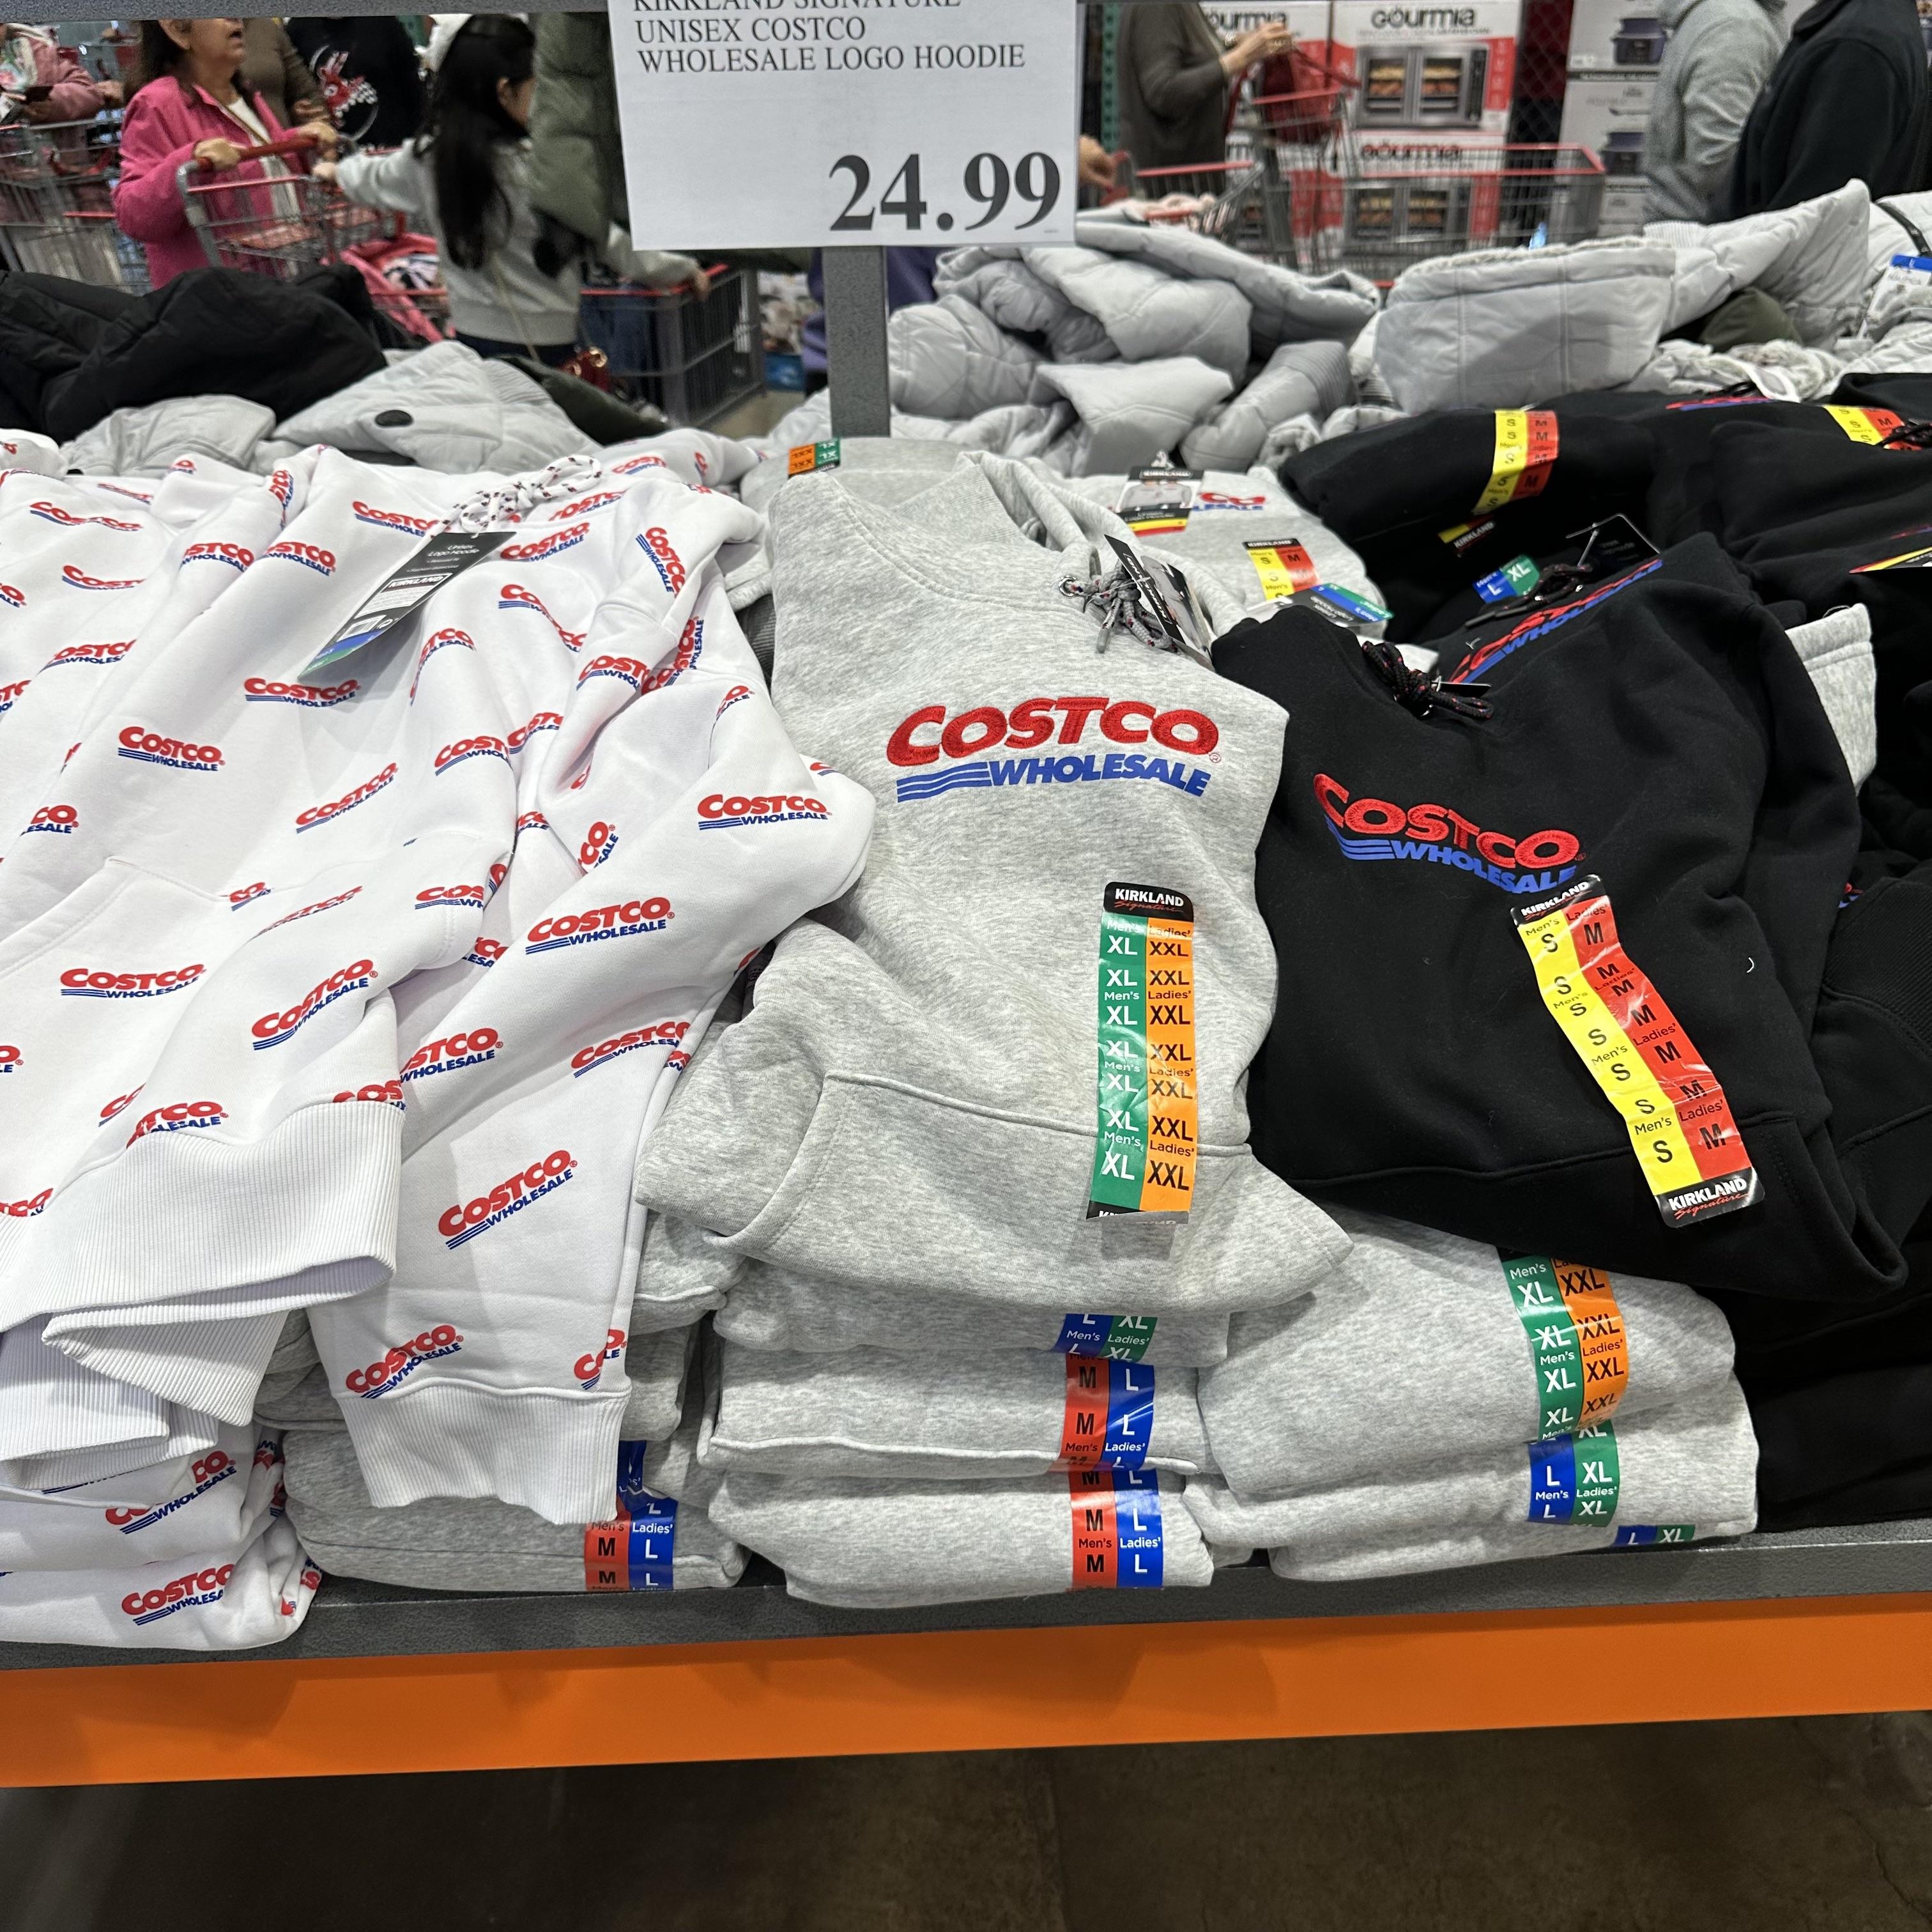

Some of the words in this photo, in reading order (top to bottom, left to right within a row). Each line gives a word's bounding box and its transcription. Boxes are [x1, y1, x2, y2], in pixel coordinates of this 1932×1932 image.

[636, 18, 743, 43] UNISEX
[751, 16, 866, 42] COSTCO
[637, 47, 816, 73] WHOLESALE
[825, 47, 905, 70] LOGO
[914, 45, 1026, 69] HOODIE
[828, 151, 1061, 232] 24.99
[1878, 418, 1892, 426] M
[384, 521, 425, 537] WHOLES
[1453, 521, 1494, 548] KIRKLAND
[500, 522, 589, 560] COSTCO
[530, 535, 585, 562] WHOLESALE
[184, 542, 255, 566] STCO
[1287, 554, 1300, 562] M
[388, 576, 444, 588] KIRKLAND
[1506, 563, 1531, 582] XL
[1487, 583, 1502, 596] L
[244, 677, 358, 700] COSTCO
[282, 691, 356, 707] WHOLESALE
[886, 696, 1219, 767] COSTCO
[119, 726, 222, 763] COSTCO
[151, 754, 218, 772] WHOLESALE
[988, 751, 1211, 797] WHOLESALE
[296, 762, 397, 825] COSTCO
[330, 776, 395, 819] WHOLESALE
[698, 794, 827, 818] COSTCO
[740, 811, 827, 825] WHOLESALE
[1314, 773, 1581, 869] COSTCO
[1390, 839, 1577, 894] WHOLESALE
[1115, 888, 1184, 907] KIRKLAND
[1521, 881, 1590, 917] KIRKLAND
[526, 896, 671, 942] COSTCO
[1525, 919, 1560, 937] Men's
[569, 919, 666, 946] WHOLESALE
[1541, 933, 1558, 953] S
[1583, 922, 1604, 946] M
[1107, 935, 1138, 956] XL
[1149, 940, 1189, 957] XXL
[60, 963, 204, 990] COSTCO
[1106, 969, 1138, 987] XL
[1149, 970, 1190, 986] XXL
[1596, 963, 1621, 980] M
[106, 974, 201, 999] WHOLESALE
[1104, 992, 1140, 1001] Men's
[1148, 990, 1191, 999] Ladies'
[1554, 976, 1572, 995] S
[1611, 979, 1635, 997] M
[252, 959, 374, 1038] COSTCO
[293, 977, 369, 1032] WHOLESALE
[1568, 1002, 1588, 1017] S
[1106, 1006, 1138, 1025] XL
[1150, 1005, 1191, 1025] XXL
[1630, 1003, 1658, 1027] M
[1588, 1028, 1607, 1046] S
[1633, 1022, 1676, 1046] Ladies'
[400, 1027, 498, 1074] STCO
[1106, 1039, 1138, 1059] XL
[1150, 1043, 1192, 1061] XXL
[1591, 1044, 1629, 1066] Men's
[1653, 1040, 1682, 1064] M
[401, 1049, 495, 1084] WHOLESALE
[1104, 1061, 1140, 1073] Men's
[1611, 1063, 1631, 1082] S
[1106, 1073, 1139, 1093] XL
[1151, 1078, 1193, 1100] XXL
[1634, 1098, 1656, 1114] S
[1678, 1098, 1724, 1123] Ladies'
[1106, 1108, 1139, 1132] XL
[1151, 1115, 1194, 1142] XXL
[1634, 1115, 1673, 1136] Men's
[1104, 1130, 1141, 1147] Men's
[1150, 1139, 1195, 1157] Ladies'
[1699, 1123, 1727, 1151] M
[1652, 1140, 1673, 1163] S
[1101, 1150, 1136, 1181] XL
[1147, 1160, 1190, 1192] XXL
[438, 1149, 571, 1236] COSTCO
[485, 1169, 572, 1227] WHOLESALE
[1668, 1177, 1748, 1211] KIRKLAND
[1510, 1263, 1547, 1280] Men's
[1560, 1268, 1606, 1297] XXL
[1517, 1280, 1554, 1308] XL
[1066, 1330, 1101, 1341] Men's
[1535, 1324, 1572, 1351] XL
[1575, 1313, 1621, 1340] XXL
[1068, 1344, 1081, 1354] L
[1107, 1334, 1149, 1346] Ladies'
[1582, 1339, 1623, 1358] Ladies'
[346, 1324, 456, 1393] COSTCO
[387, 1342, 462, 1387] WHOLESALE
[1104, 1347, 1133, 1361] XL
[1540, 1351, 1575, 1367] Men's
[1078, 1366, 1096, 1388] M
[1125, 1368, 1139, 1391] L
[1544, 1367, 1576, 1393] XL
[1585, 1357, 1625, 1383] XXL
[1583, 1392, 1618, 1416] XXL
[1076, 1412, 1093, 1436] M
[1123, 1414, 1135, 1436] L
[1545, 1407, 1574, 1428] XL
[1066, 1442, 1098, 1452] Men's
[1105, 1442, 1146, 1452] Ladies'
[1547, 1465, 1560, 1487] L
[1581, 1460, 1613, 1483] XL
[152, 1466, 237, 1520] WHOLESALE
[1535, 1491, 1569, 1501] Men's
[1576, 1486, 1618, 1498] Ladies'
[1543, 1504, 1556, 1519] L
[1578, 1500, 1607, 1516] XL
[632, 1523, 673, 1533] Ladies'
[1086, 1509, 1103, 1532] M
[1133, 1508, 1147, 1531] L
[598, 1537, 615, 1556] M
[1078, 1537, 1112, 1549] Men's
[1119, 1536, 1161, 1549] Ladies'
[1628, 1531, 1638, 1545] L
[1660, 1528, 1685, 1543] XL
[645, 1539, 658, 1559] L
[1087, 1554, 1105, 1572] M
[1135, 1554, 1147, 1574] L
[599, 1571, 616, 1584] M
[646, 1573, 659, 1586] L
[167, 1588, 223, 1613] WHOLESA
